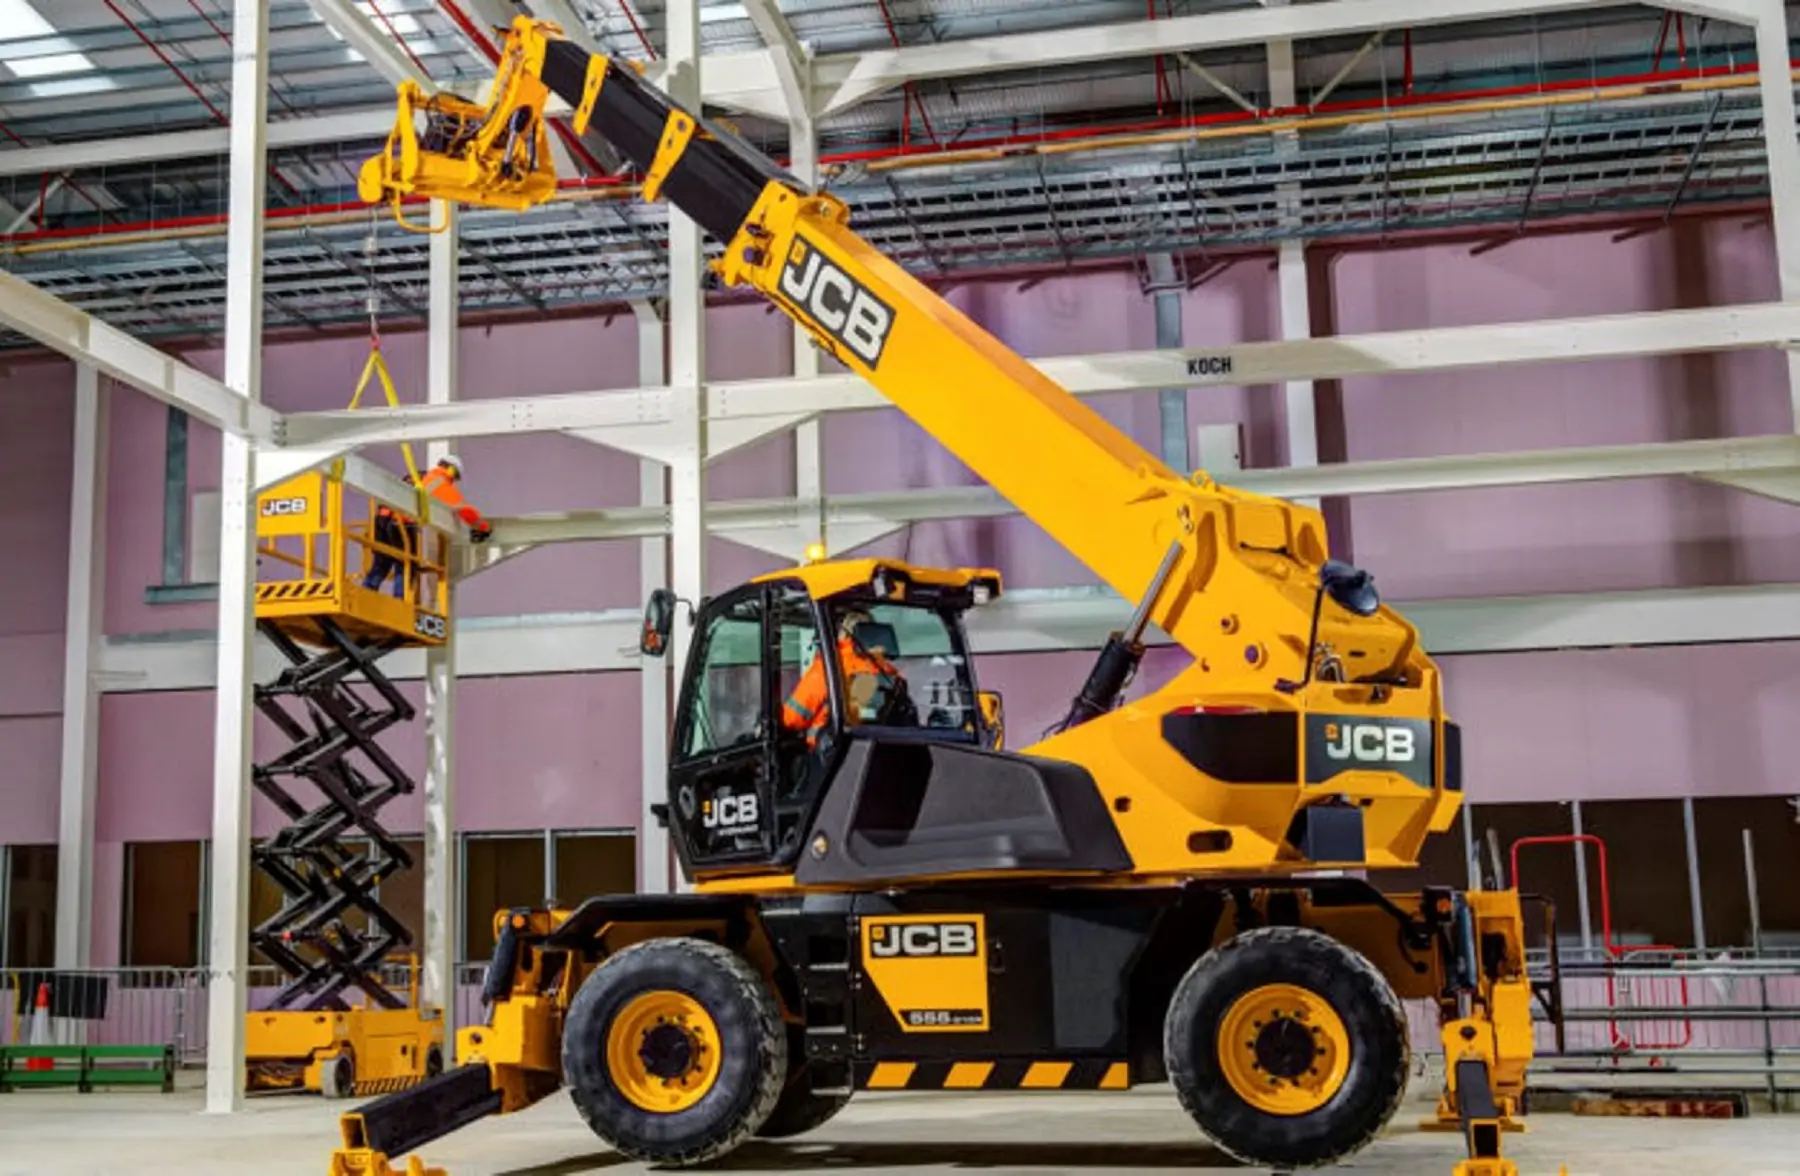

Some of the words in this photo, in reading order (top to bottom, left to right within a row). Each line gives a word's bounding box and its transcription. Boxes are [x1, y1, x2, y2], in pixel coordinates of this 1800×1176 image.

[783, 252, 889, 361] JCB
[1187, 356, 1232, 375] KOCH
[262, 498, 306, 516] JCB
[415, 613, 446, 638] JCB
[1326, 724, 1415, 762] JCB
[703, 794, 758, 828] JCB
[872, 924, 976, 956] JCB
